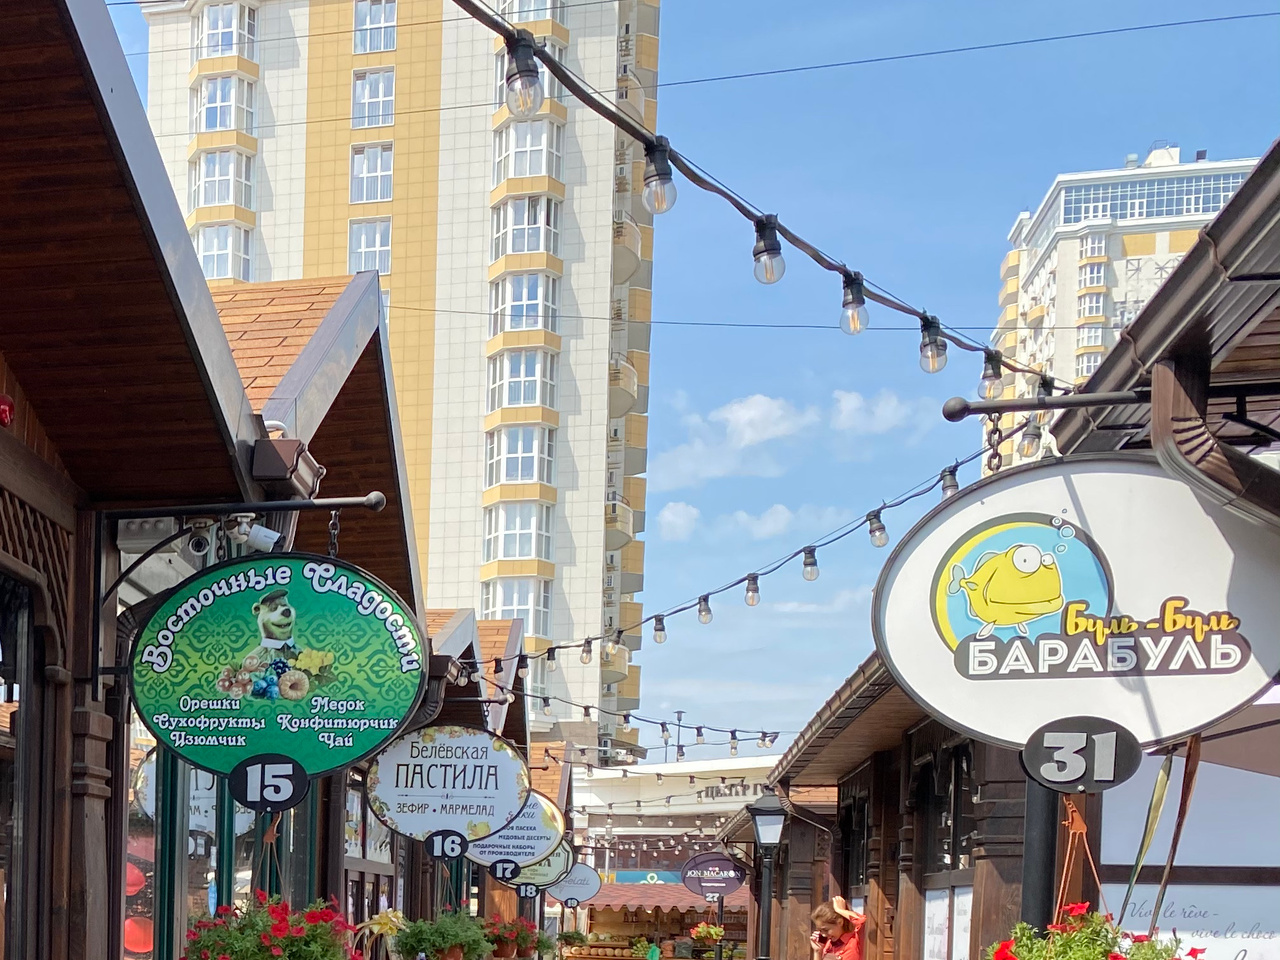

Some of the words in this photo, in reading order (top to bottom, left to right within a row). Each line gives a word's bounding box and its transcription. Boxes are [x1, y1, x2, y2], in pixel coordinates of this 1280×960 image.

[141, 565, 293, 673] Восточные
[302, 562, 420, 673] Сладости
[968, 633, 1243, 676] БАРАБУЛЬ
[179, 695, 241, 712] Орешки
[310, 697, 365, 713] Медок
[153, 713, 266, 731] Сухофрукты
[277, 714, 399, 732] Конфитюрчик
[170, 731, 247, 747] Изюмчик
[318, 732, 355, 749] Чай
[410, 741, 488, 760] Белёвская
[1039, 731, 1118, 782] 31
[246, 763, 294, 802] 15
[394, 763, 499, 791] ПАСТИЛА
[396, 802, 430, 815] ЗЕФИР
[440, 804, 495, 817] МАРМЕЛАД
[432, 835, 462, 858] 16
[495, 863, 516, 878] 17
[685, 870, 701, 878] JON
[520, 885, 537, 897] 18
[705, 893, 720, 902] 27
[1127, 899, 1157, 919] Viv
[1163, 901, 1178, 919] le
[1180, 904, 1211, 919] rêve
[1191, 929, 1220, 939] vive
[1223, 921, 1239, 939] le
